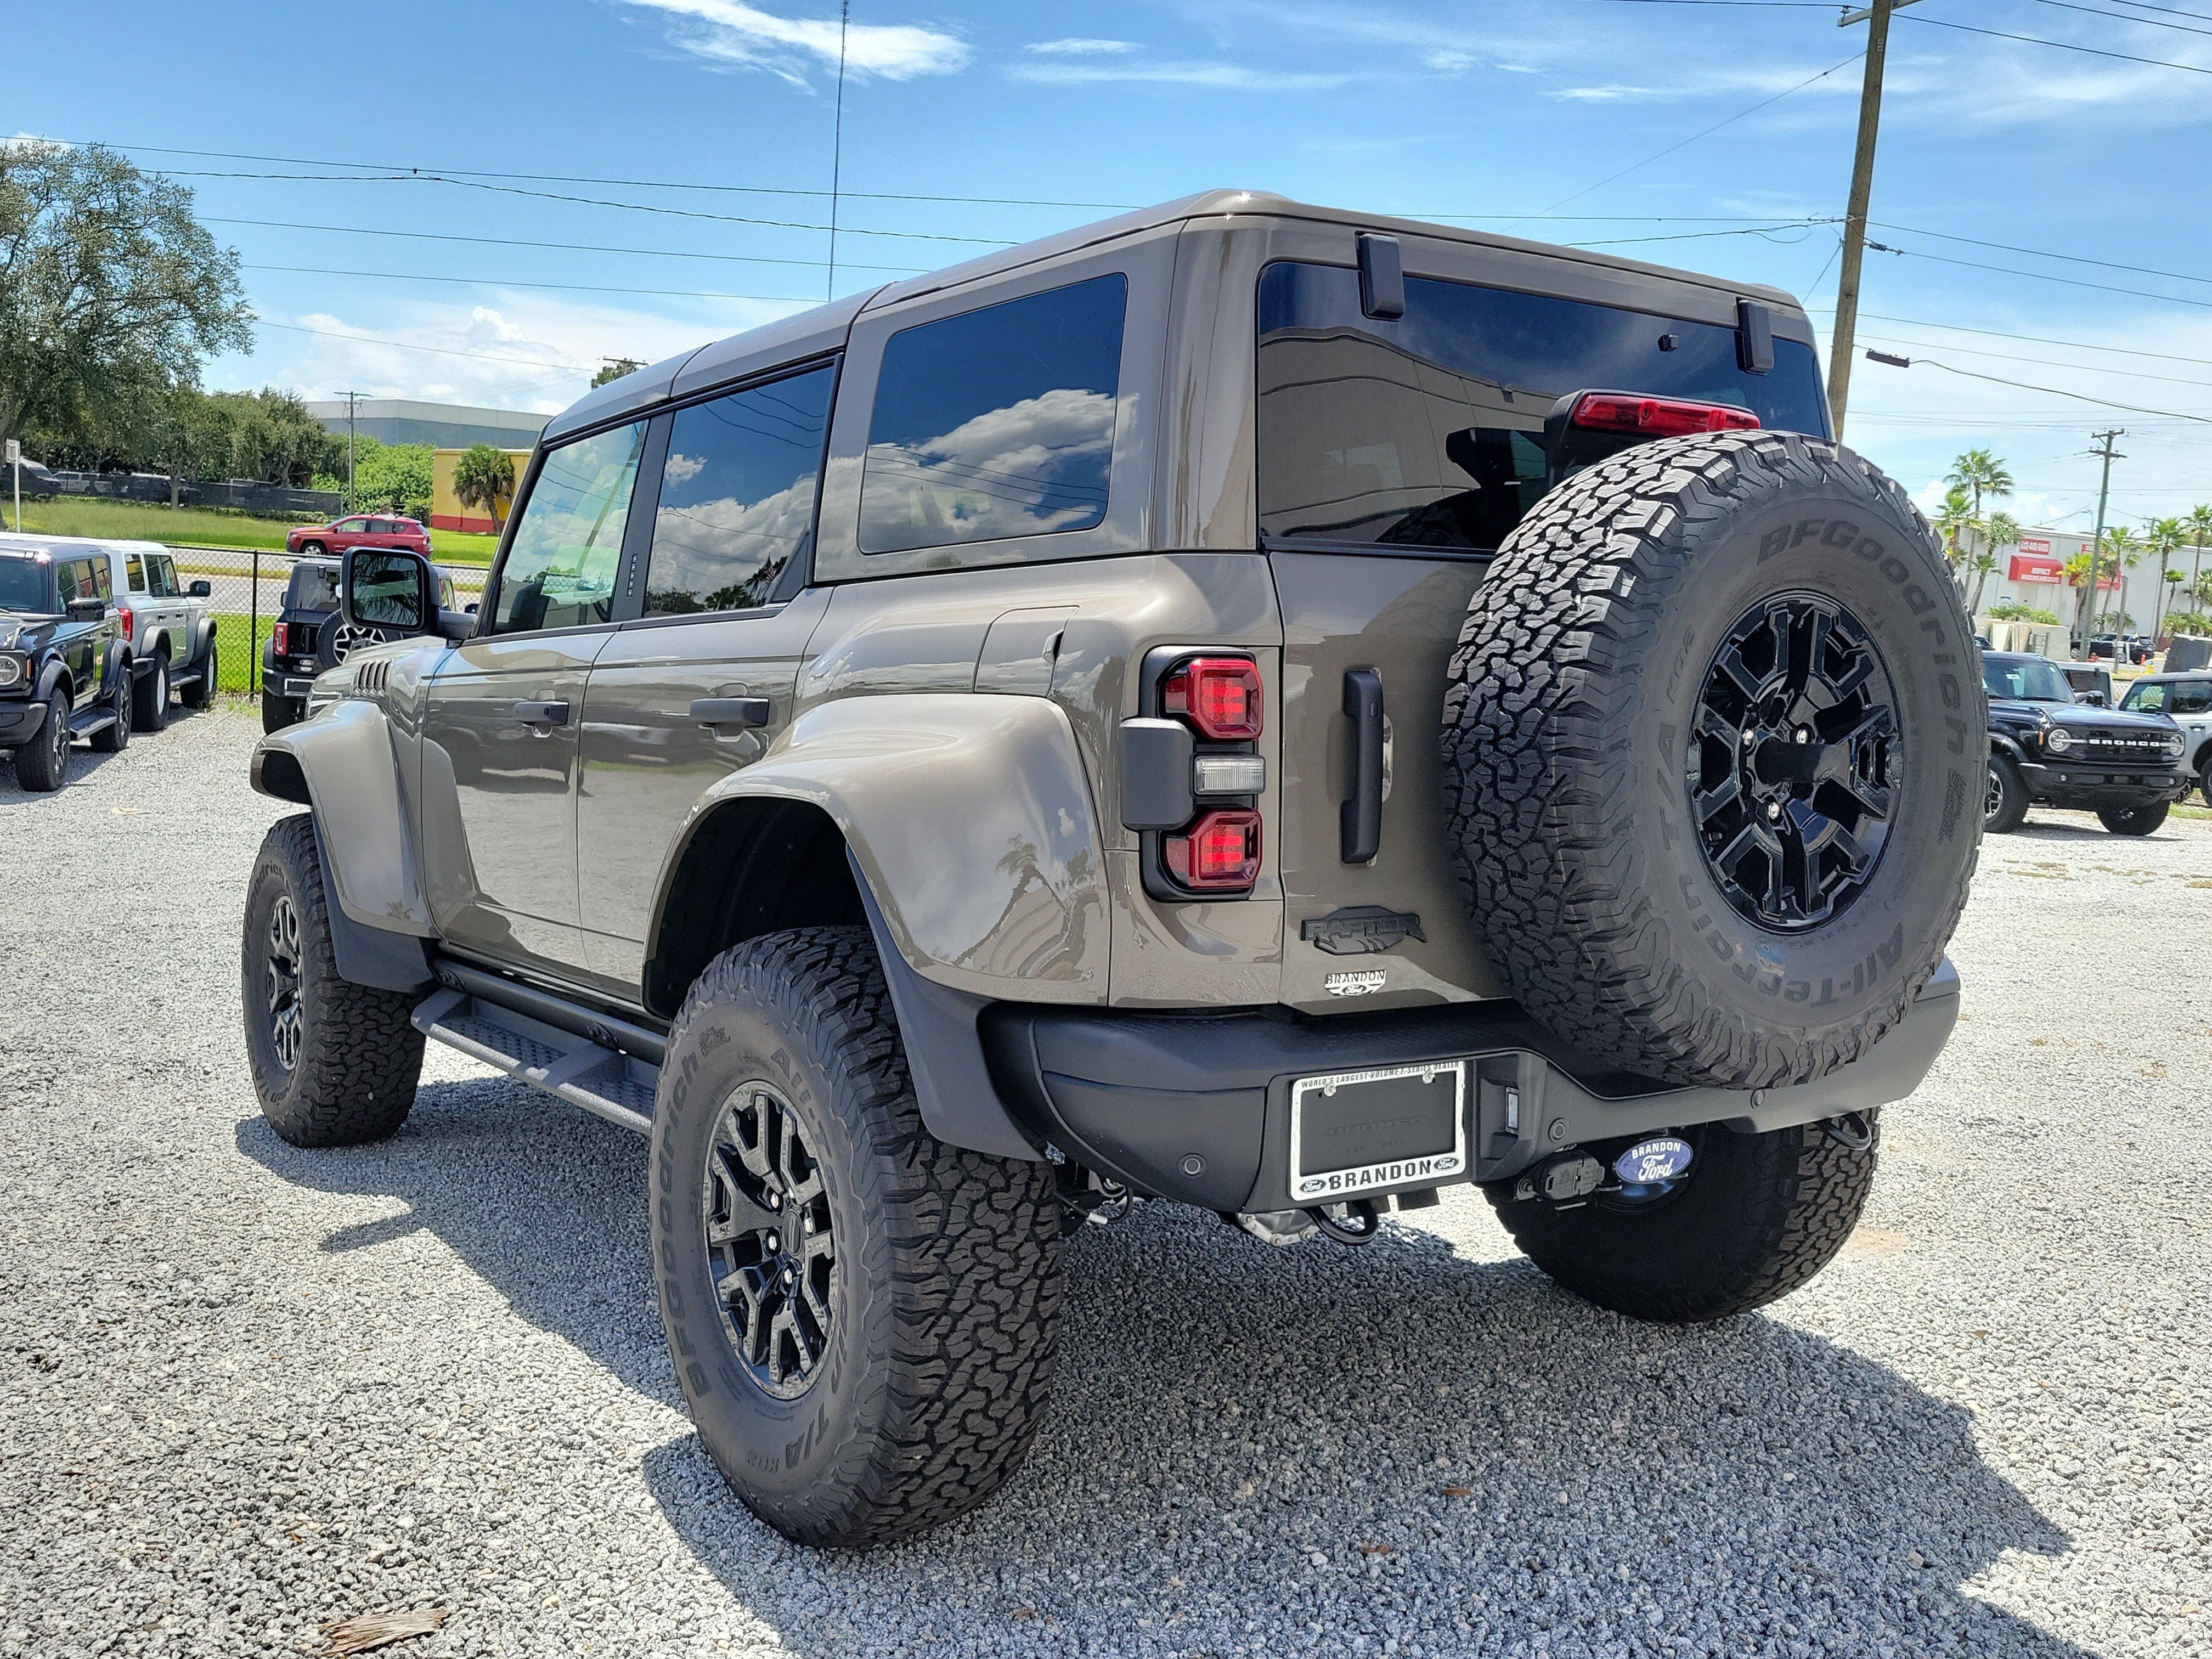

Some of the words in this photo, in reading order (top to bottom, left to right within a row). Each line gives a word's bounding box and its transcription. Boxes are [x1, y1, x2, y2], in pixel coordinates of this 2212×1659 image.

[1757, 519, 1967, 755] BFGoodrich
[2089, 738, 2160, 747] BRONCO
[1301, 913, 1427, 950] RAPTOR
[1679, 875, 1903, 1006] All-Terrain
[1326, 969, 1386, 985] BRANDON
[1345, 985, 1365, 995] Ford
[1301, 1077, 1334, 1088] WORLD'S
[1336, 1073, 1368, 1083] LARGEST
[1370, 1069, 1398, 1079] VOLUME
[1434, 1062, 1459, 1070] DEALER
[1632, 1142, 1681, 1159] BRANDON
[1329, 1160, 1431, 1190] BRANDON
[1437, 1158, 1455, 1170] Ford
[1638, 1154, 1674, 1181] Ford
[1303, 1180, 1322, 1192] Ford
[659, 1053, 710, 1398] BFGoodrich
